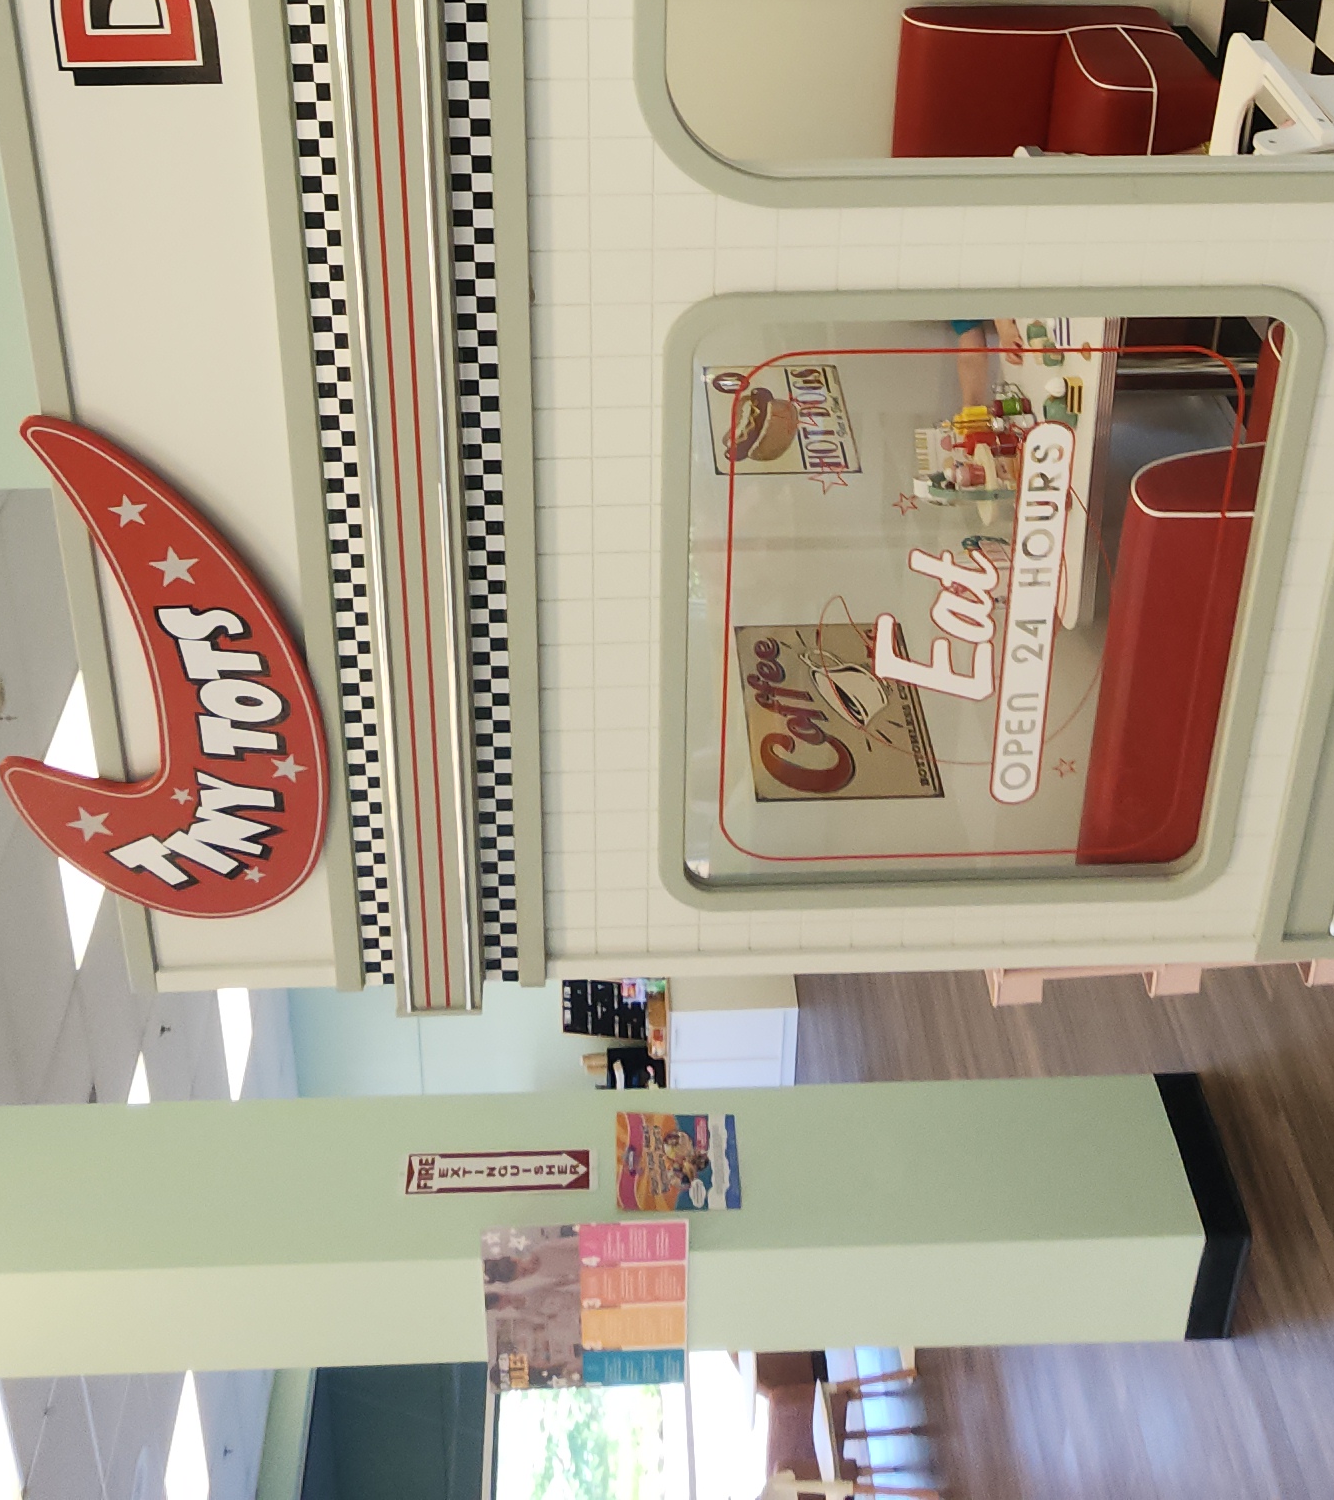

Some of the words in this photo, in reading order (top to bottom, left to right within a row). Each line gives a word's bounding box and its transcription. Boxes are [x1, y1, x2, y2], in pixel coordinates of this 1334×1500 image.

[790, 368, 831, 418] DOGS
[802, 427, 845, 469] HOT
[1017, 443, 1065, 588] HOURS
[872, 548, 1000, 700] Eat
[1011, 618, 1047, 664] 24
[153, 606, 292, 761] TOTS
[746, 637, 857, 793] Coffee
[901, 703, 931, 786] BOTTOMLESS
[999, 692, 1040, 791] OPEN
[104, 768, 286, 890] TINY
[416, 1157, 435, 1189] FIRE
[438, 1163, 579, 1179] EXTINGUISHER
[581, 1256, 601, 1266] 4
